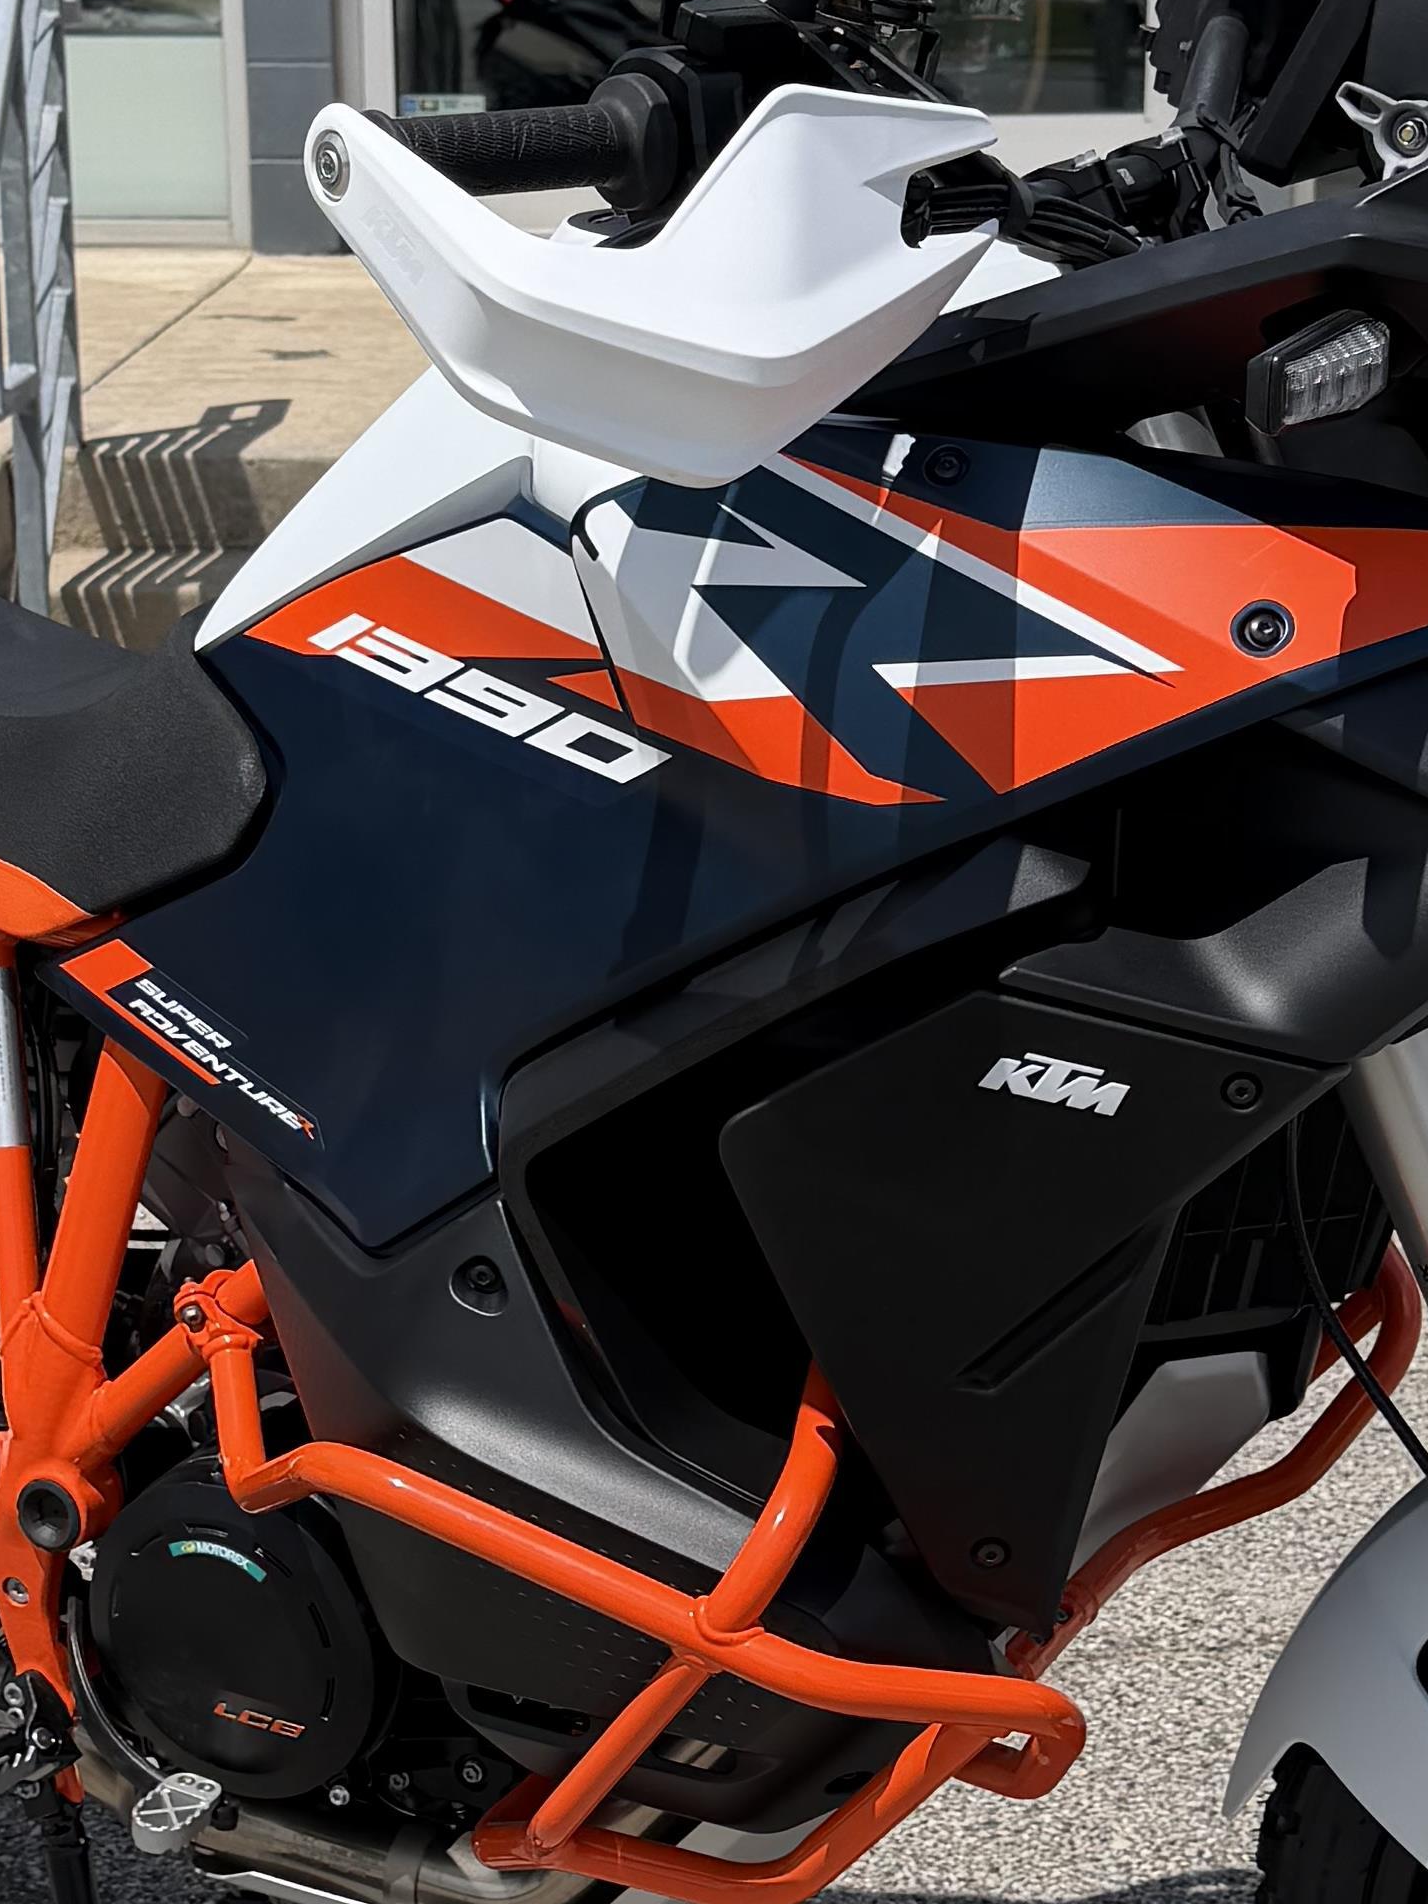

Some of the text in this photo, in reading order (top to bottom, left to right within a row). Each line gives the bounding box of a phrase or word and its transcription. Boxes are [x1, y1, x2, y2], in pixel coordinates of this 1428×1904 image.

[307, 612, 673, 784] 1390
[128, 998, 303, 1131] ADVENTURE
[134, 977, 233, 1050] SUPER
[978, 1052, 1131, 1117] KTM
